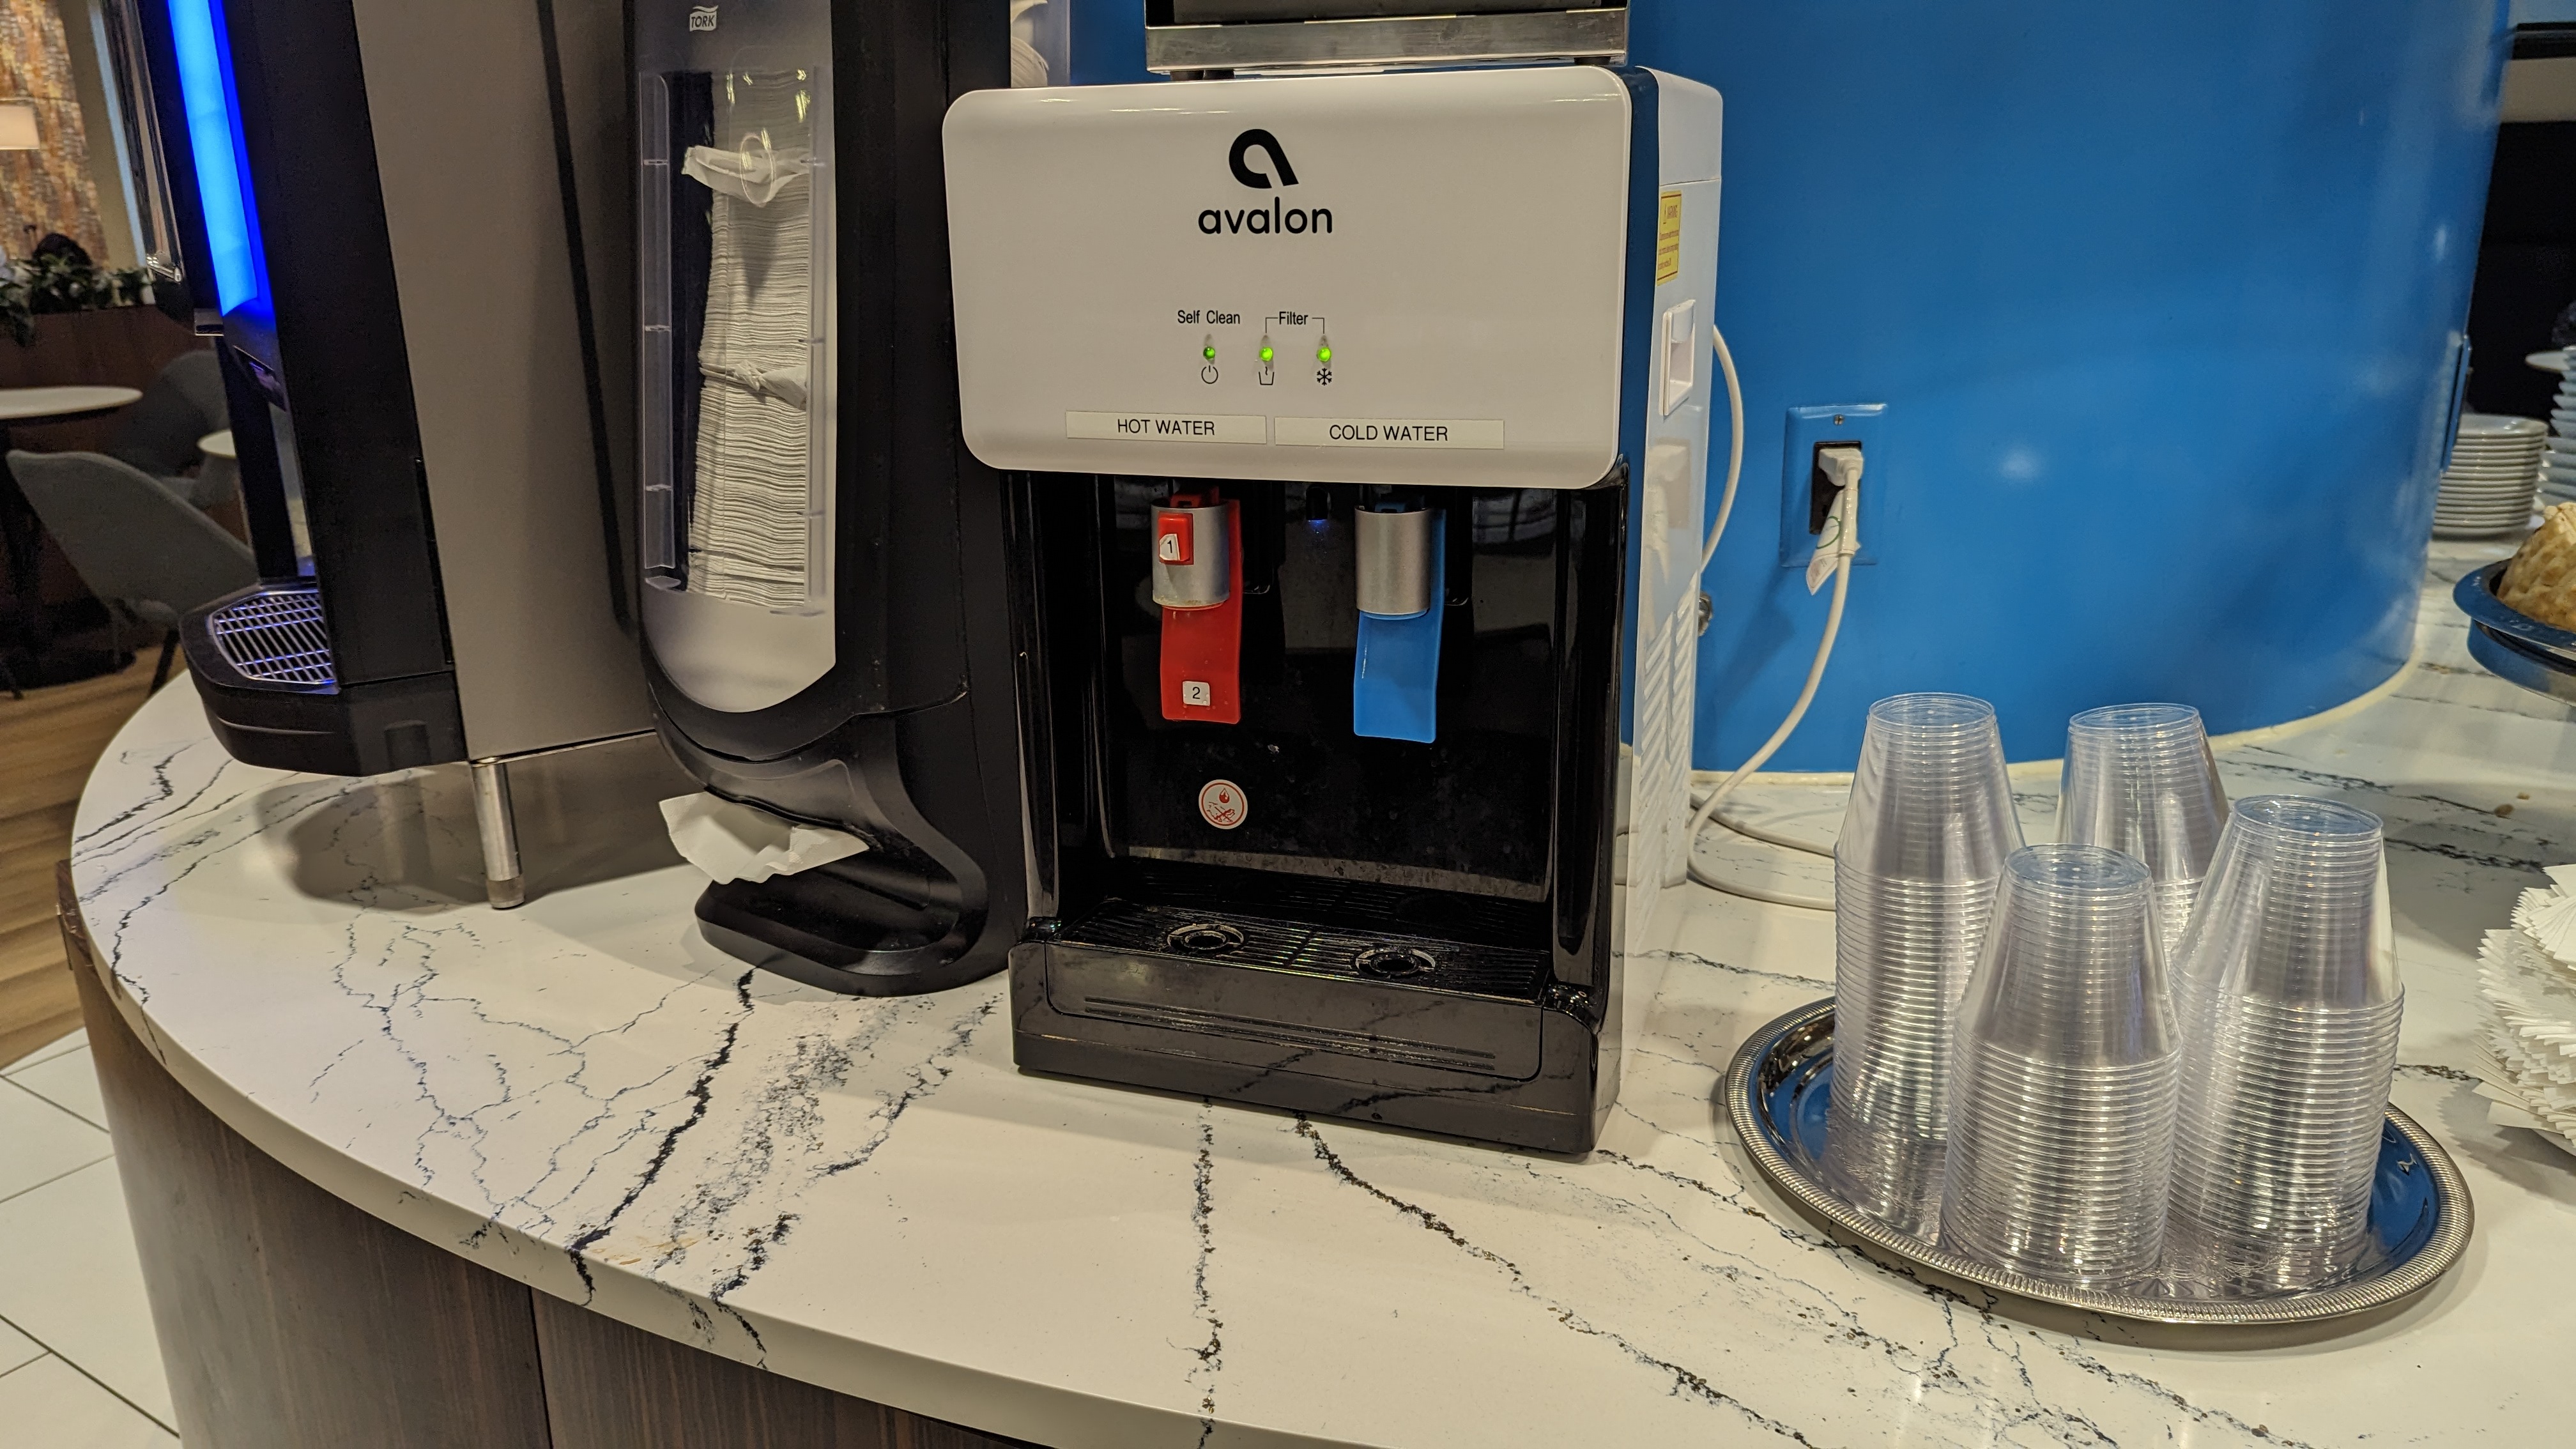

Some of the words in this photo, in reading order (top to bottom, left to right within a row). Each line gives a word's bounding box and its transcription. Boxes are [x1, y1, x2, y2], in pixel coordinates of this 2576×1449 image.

[691, 15, 715, 28] TORK
[1198, 196, 1332, 234] avalon
[1177, 310, 1200, 324] Self
[1206, 310, 1241, 325] Clean
[1278, 311, 1308, 325] Filter
[1117, 418, 1151, 434] HOT
[1155, 419, 1215, 436] WATER
[1329, 424, 1378, 440] COLD
[1383, 425, 1448, 441] WATER
[1167, 540, 1173, 554] 1
[1192, 686, 1200, 700] 2
